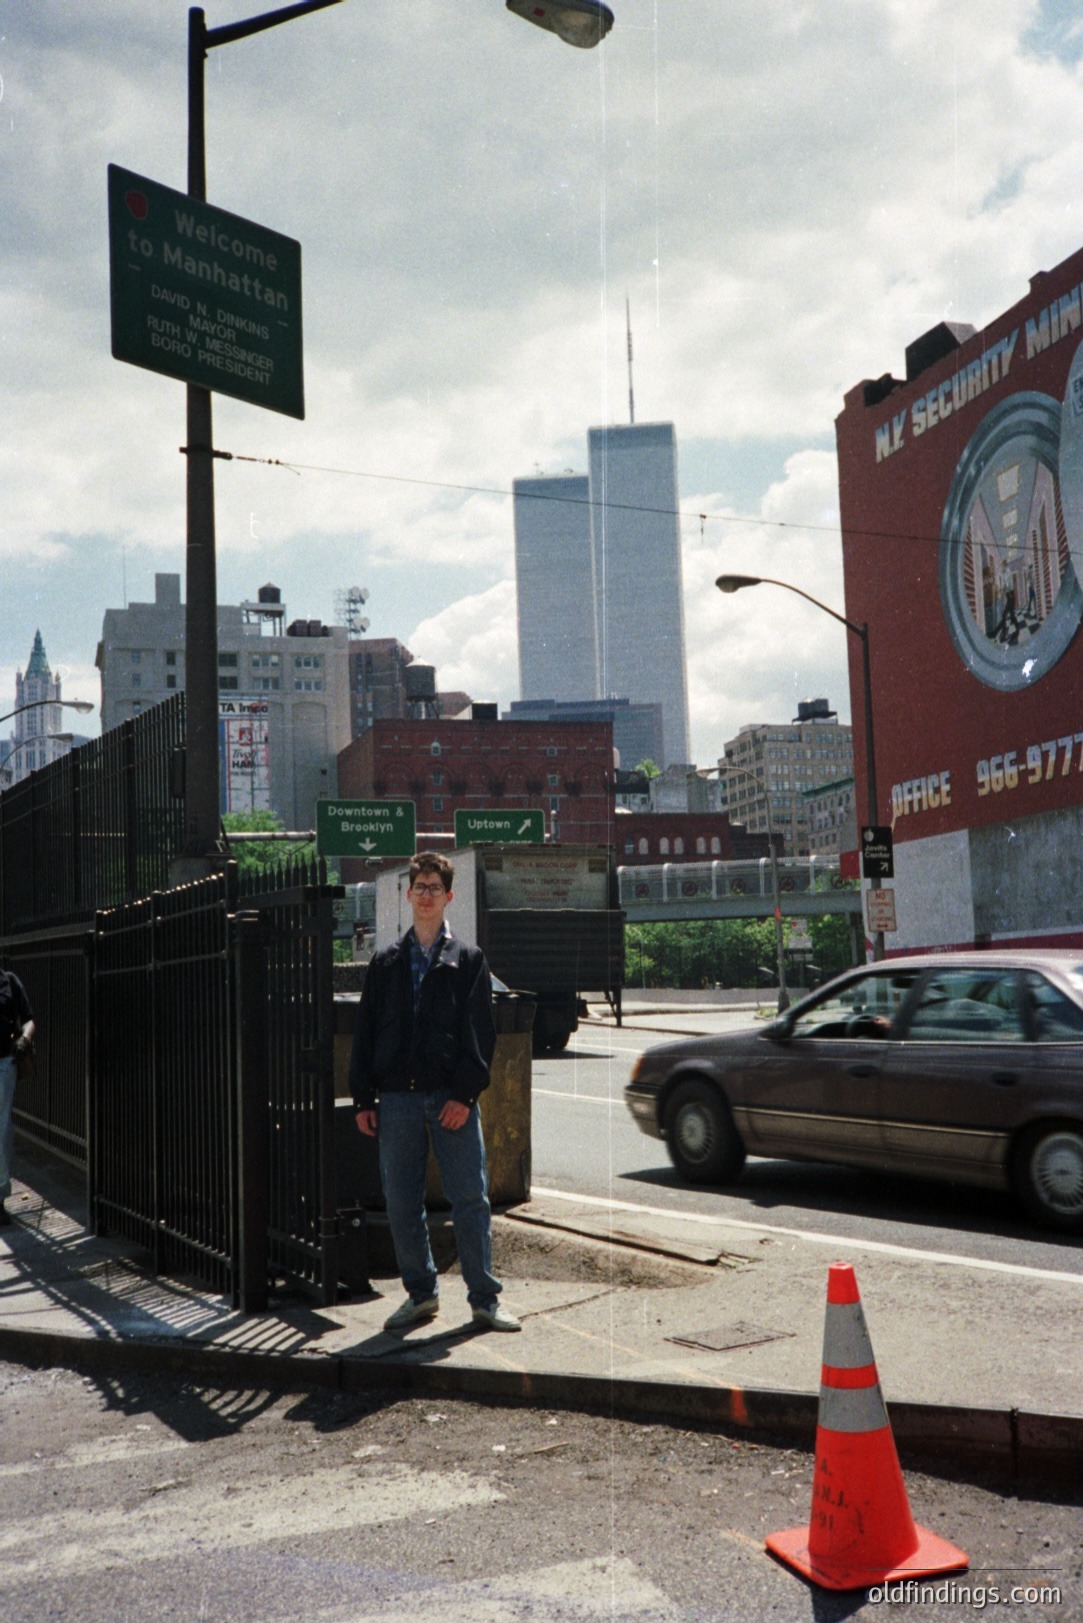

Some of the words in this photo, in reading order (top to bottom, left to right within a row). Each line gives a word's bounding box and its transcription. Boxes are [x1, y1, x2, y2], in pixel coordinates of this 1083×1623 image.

[174, 209, 278, 271] Welcome
[128, 229, 154, 258] to
[163, 242, 289, 311] Manhattan
[151, 284, 190, 310] DAVID
[197, 301, 209, 318] N.
[217, 309, 270, 340] DINKINS
[189, 314, 237, 342] MAYOR
[147, 315, 181, 338] RUTH
[186, 328, 201, 346] W.
[205, 337, 275, 372] MESSINGER
[151, 333, 191, 358] BORO
[198, 351, 271, 385] PRESIDENT
[911, 326, 1020, 438] SECURITY
[1024, 281, 1083, 360] MIN
[328, 806, 389, 817] Downtown
[396, 806, 404, 817] &
[891, 770, 952, 819] OFFICE
[341, 821, 393, 833] Brooklyn
[467, 819, 511, 830] Uptown
[864, 844, 887, 852] Javits
[864, 851, 890, 859] Center
[875, 892, 886, 900] NO
